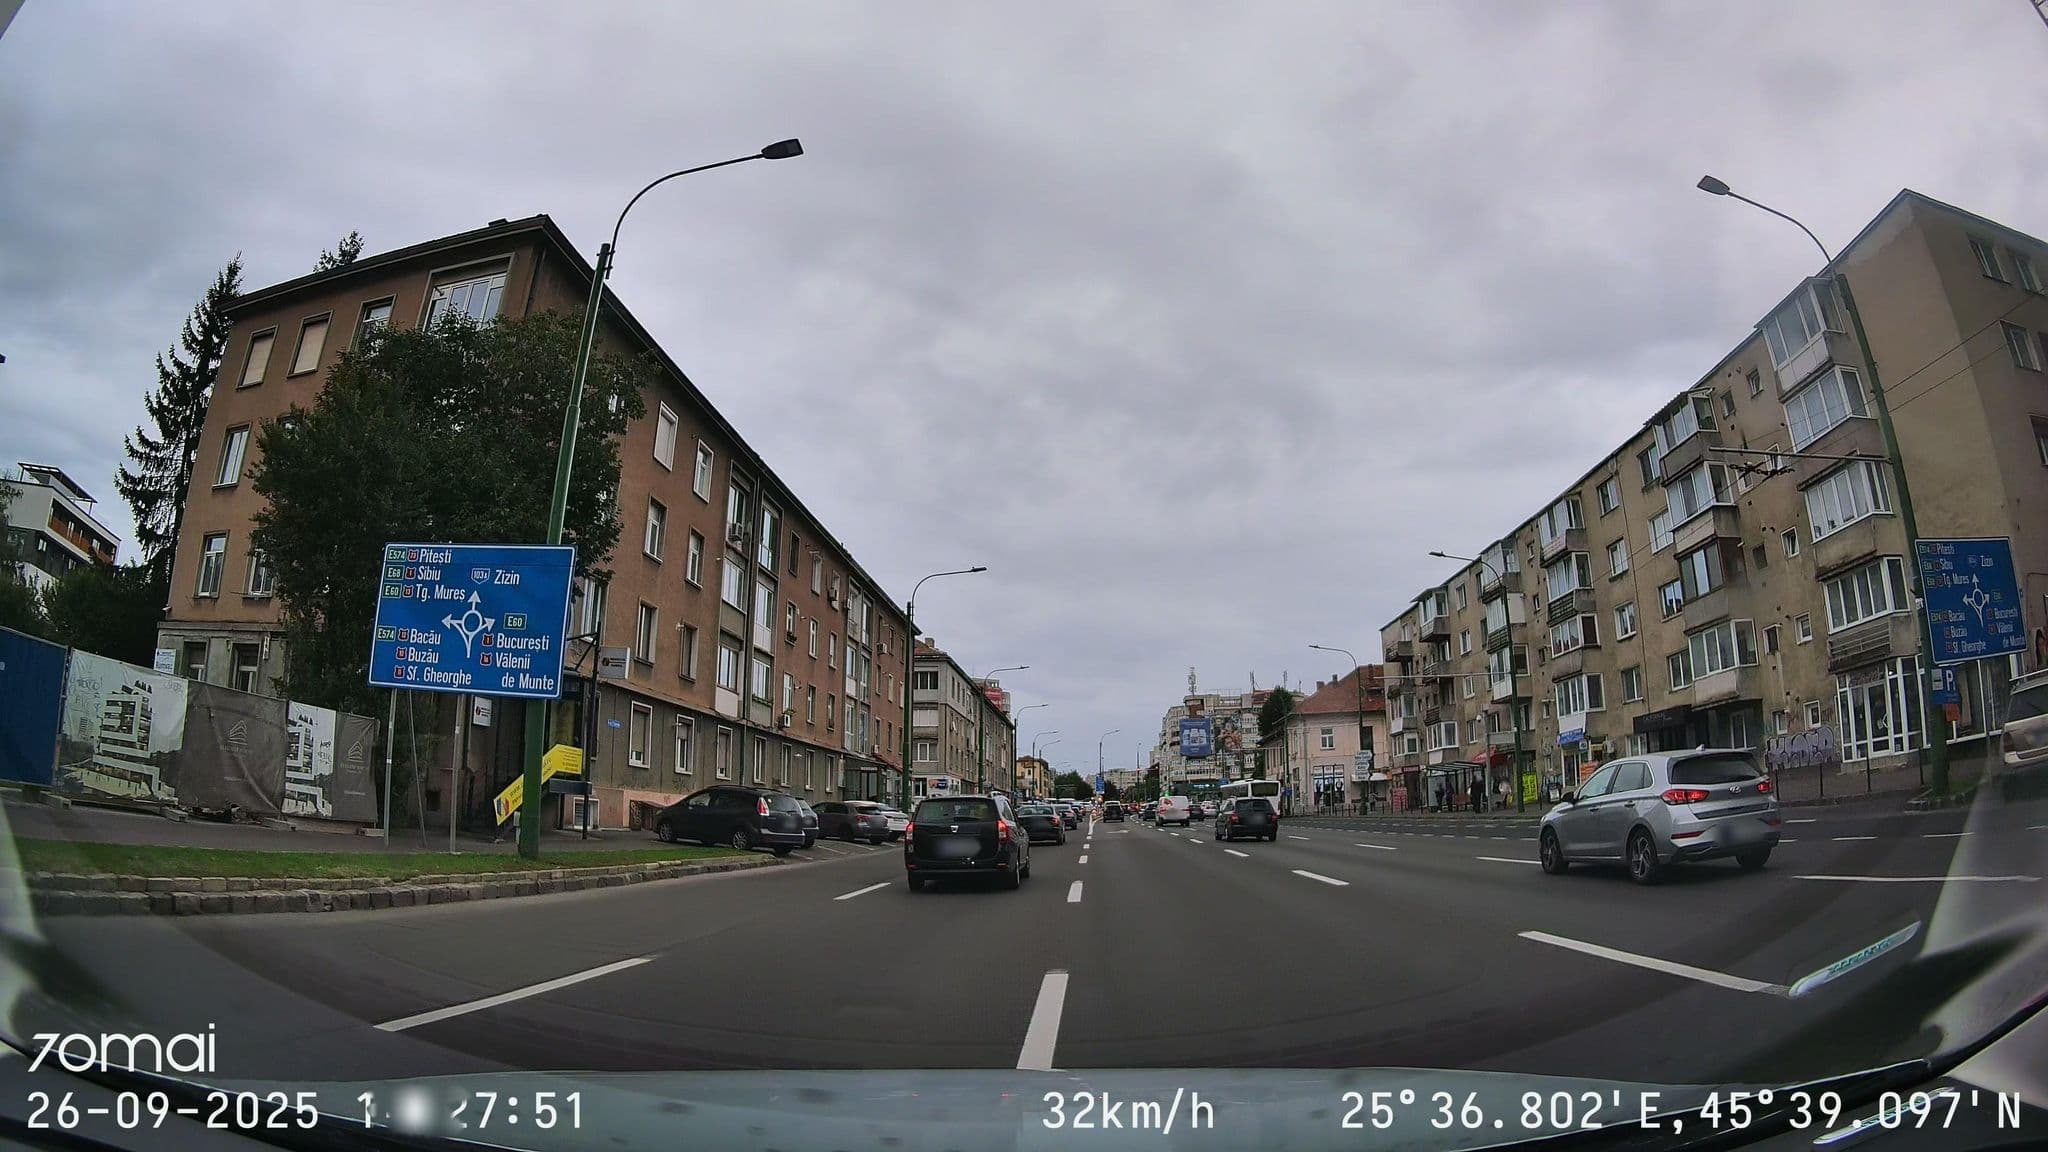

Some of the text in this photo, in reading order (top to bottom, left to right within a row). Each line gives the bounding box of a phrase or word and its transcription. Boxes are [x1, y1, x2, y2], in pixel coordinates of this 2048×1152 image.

[388, 550, 406, 560] E574
[387, 567, 401, 578] E68
[417, 565, 441, 581] Sibiu
[493, 569, 520, 585] Zizin
[384, 585, 399, 596] E60
[416, 583, 431, 602] Tg.
[507, 616, 523, 627] E60
[377, 628, 395, 639] E574
[410, 628, 441, 645] Bacău
[496, 632, 550, 652] București
[408, 646, 439, 664] Buzău
[495, 652, 531, 669] Vălenii
[406, 665, 420, 681] Sf.
[423, 666, 472, 688] Gheorghe
[501, 671, 554, 691] de Munte
